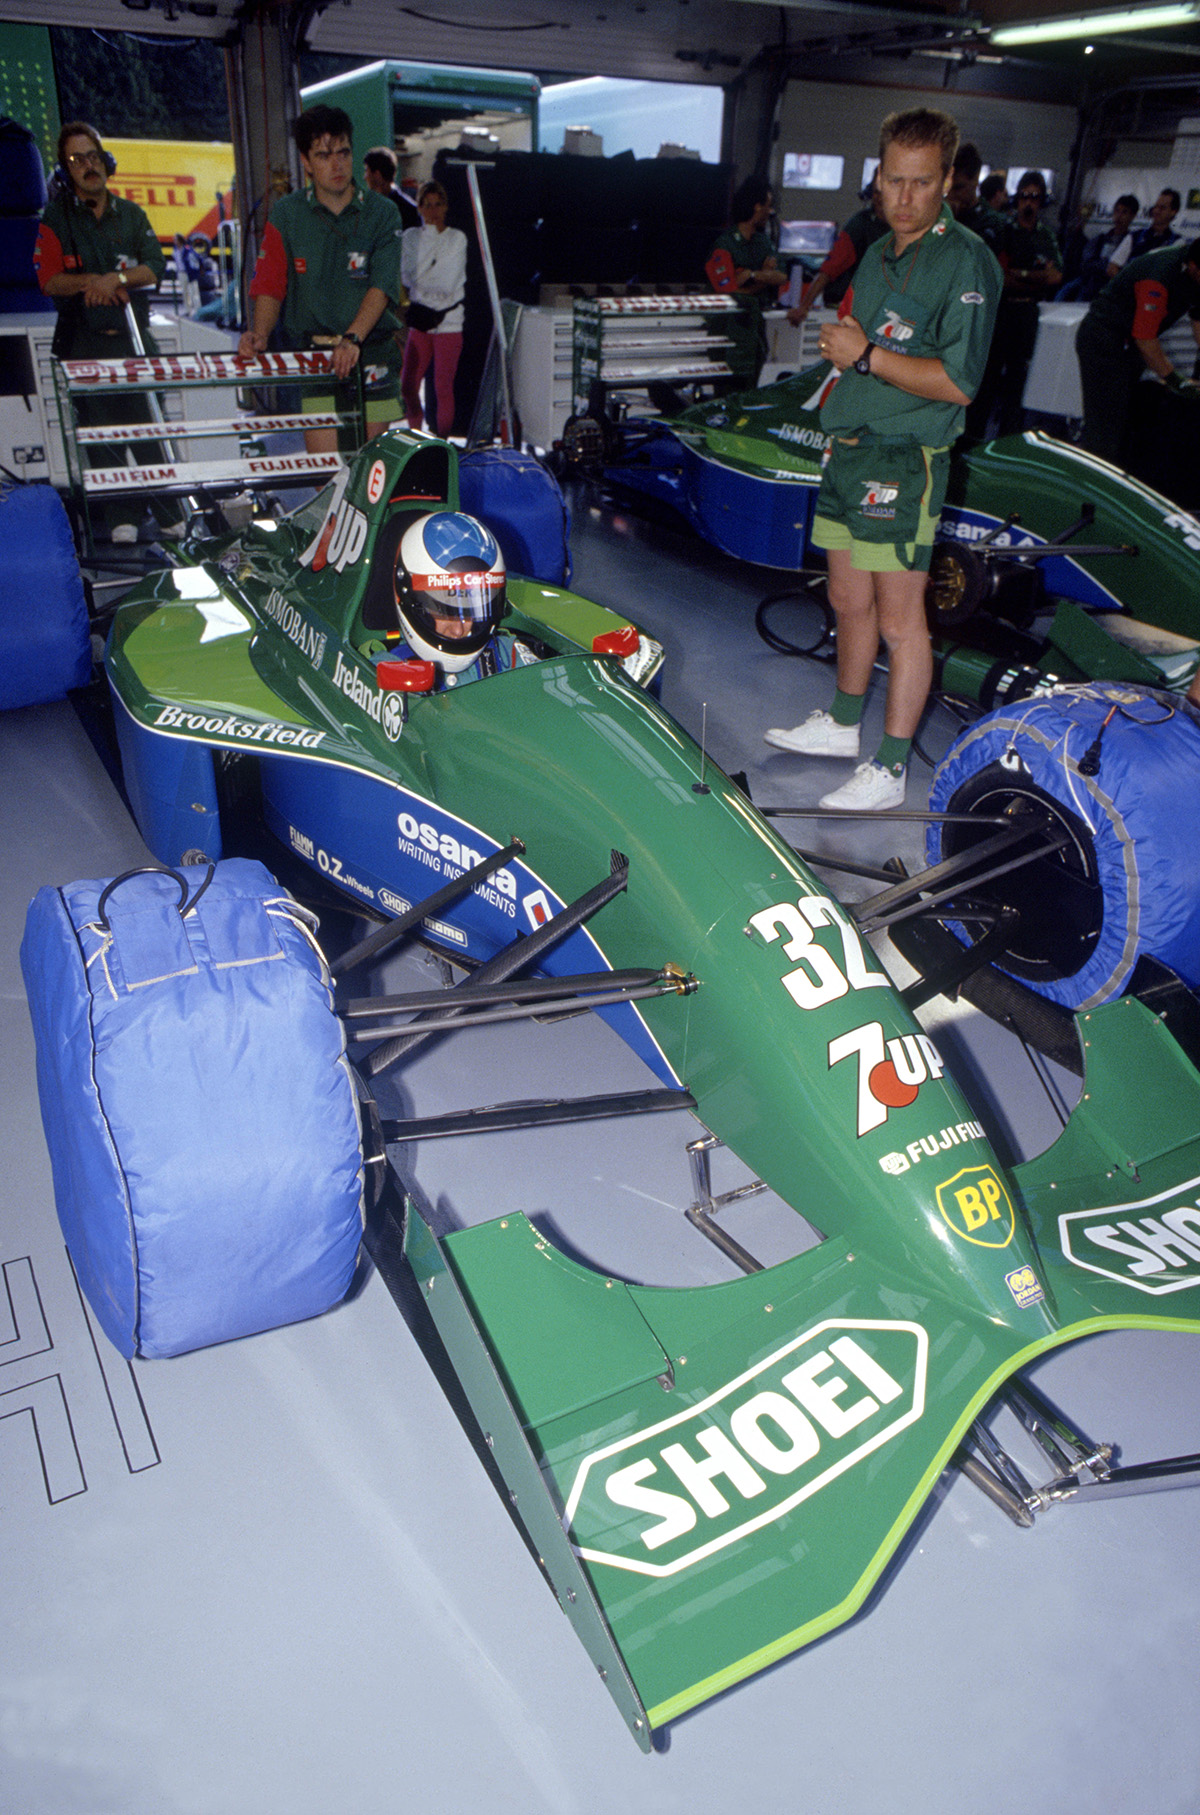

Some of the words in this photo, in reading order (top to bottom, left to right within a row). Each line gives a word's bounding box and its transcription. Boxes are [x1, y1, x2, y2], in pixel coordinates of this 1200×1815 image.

[231, 416, 337, 430] FUJIFILM
[249, 456, 338, 472] FUJIFILM
[370, 467, 382, 498] E
[428, 575, 461, 590] Philips
[464, 574, 484, 586] Car
[265, 588, 320, 660] ISMOBAN
[332, 651, 384, 724] Ireland
[154, 705, 327, 749] Brooksfield
[317, 849, 347, 883] O.Z.
[346, 874, 375, 899] Wheels
[398, 837, 441, 872] WRITING
[747, 896, 893, 1011] 32
[954, 1178, 1001, 1232] BP
[605, 1335, 903, 1550] SHOEI
